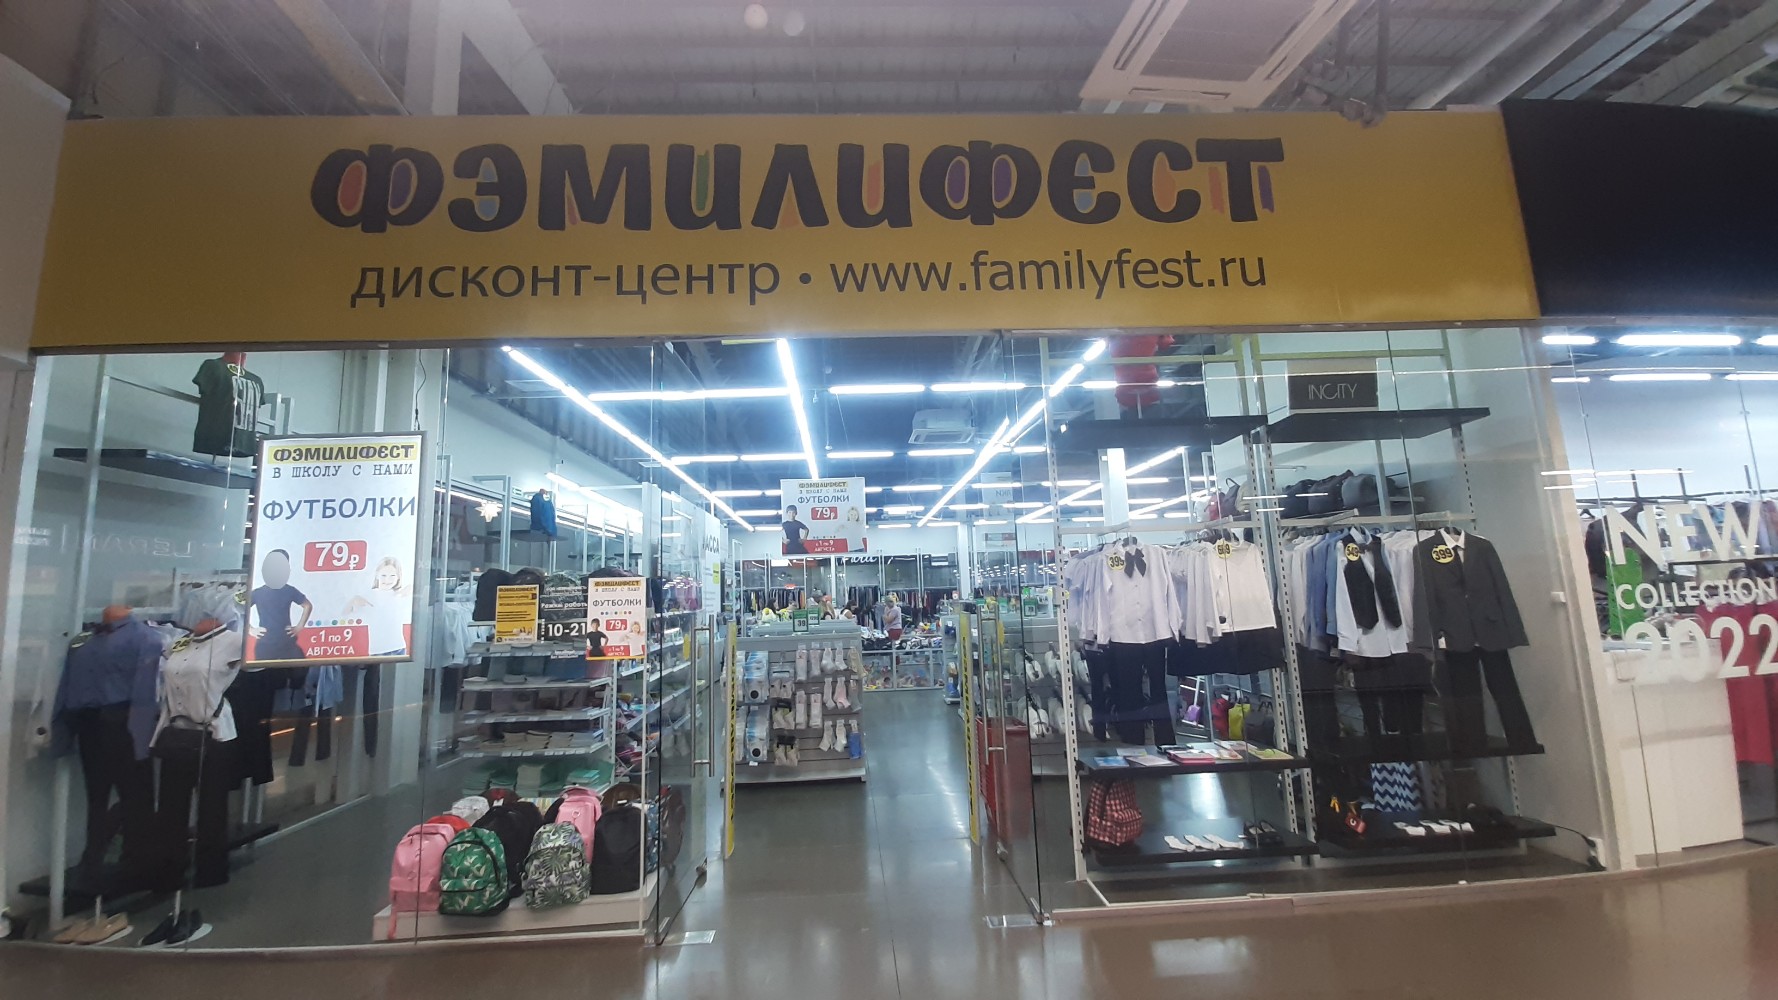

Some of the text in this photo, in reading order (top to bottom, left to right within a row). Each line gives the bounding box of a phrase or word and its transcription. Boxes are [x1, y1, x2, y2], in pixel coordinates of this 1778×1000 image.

[310, 137, 1284, 233] ФЭМИЛИФЕСТ
[350, 248, 1267, 308] дисконт-центр www.familyfest.ru
[1308, 383, 1358, 400] INCITY
[273, 444, 415, 462] ФЭМИЛИФЕСТ
[272, 463, 414, 479] В ШКОЛУ С НАМИ
[797, 495, 850, 504] ФУТБОЛКИ
[263, 496, 416, 521] ФУТБОЛКИ
[1604, 501, 1761, 574] NEW
[1433, 547, 1453, 560] 399
[1616, 576, 1778, 610] COLLECTION
[592, 599, 642, 607] ФУТБОЛКИ
[311, 629, 353, 643] с 1 по 9
[547, 622, 586, 637] 10-21
[306, 645, 355, 657] АВГУСТА
[1625, 613, 1778, 684] 2022
